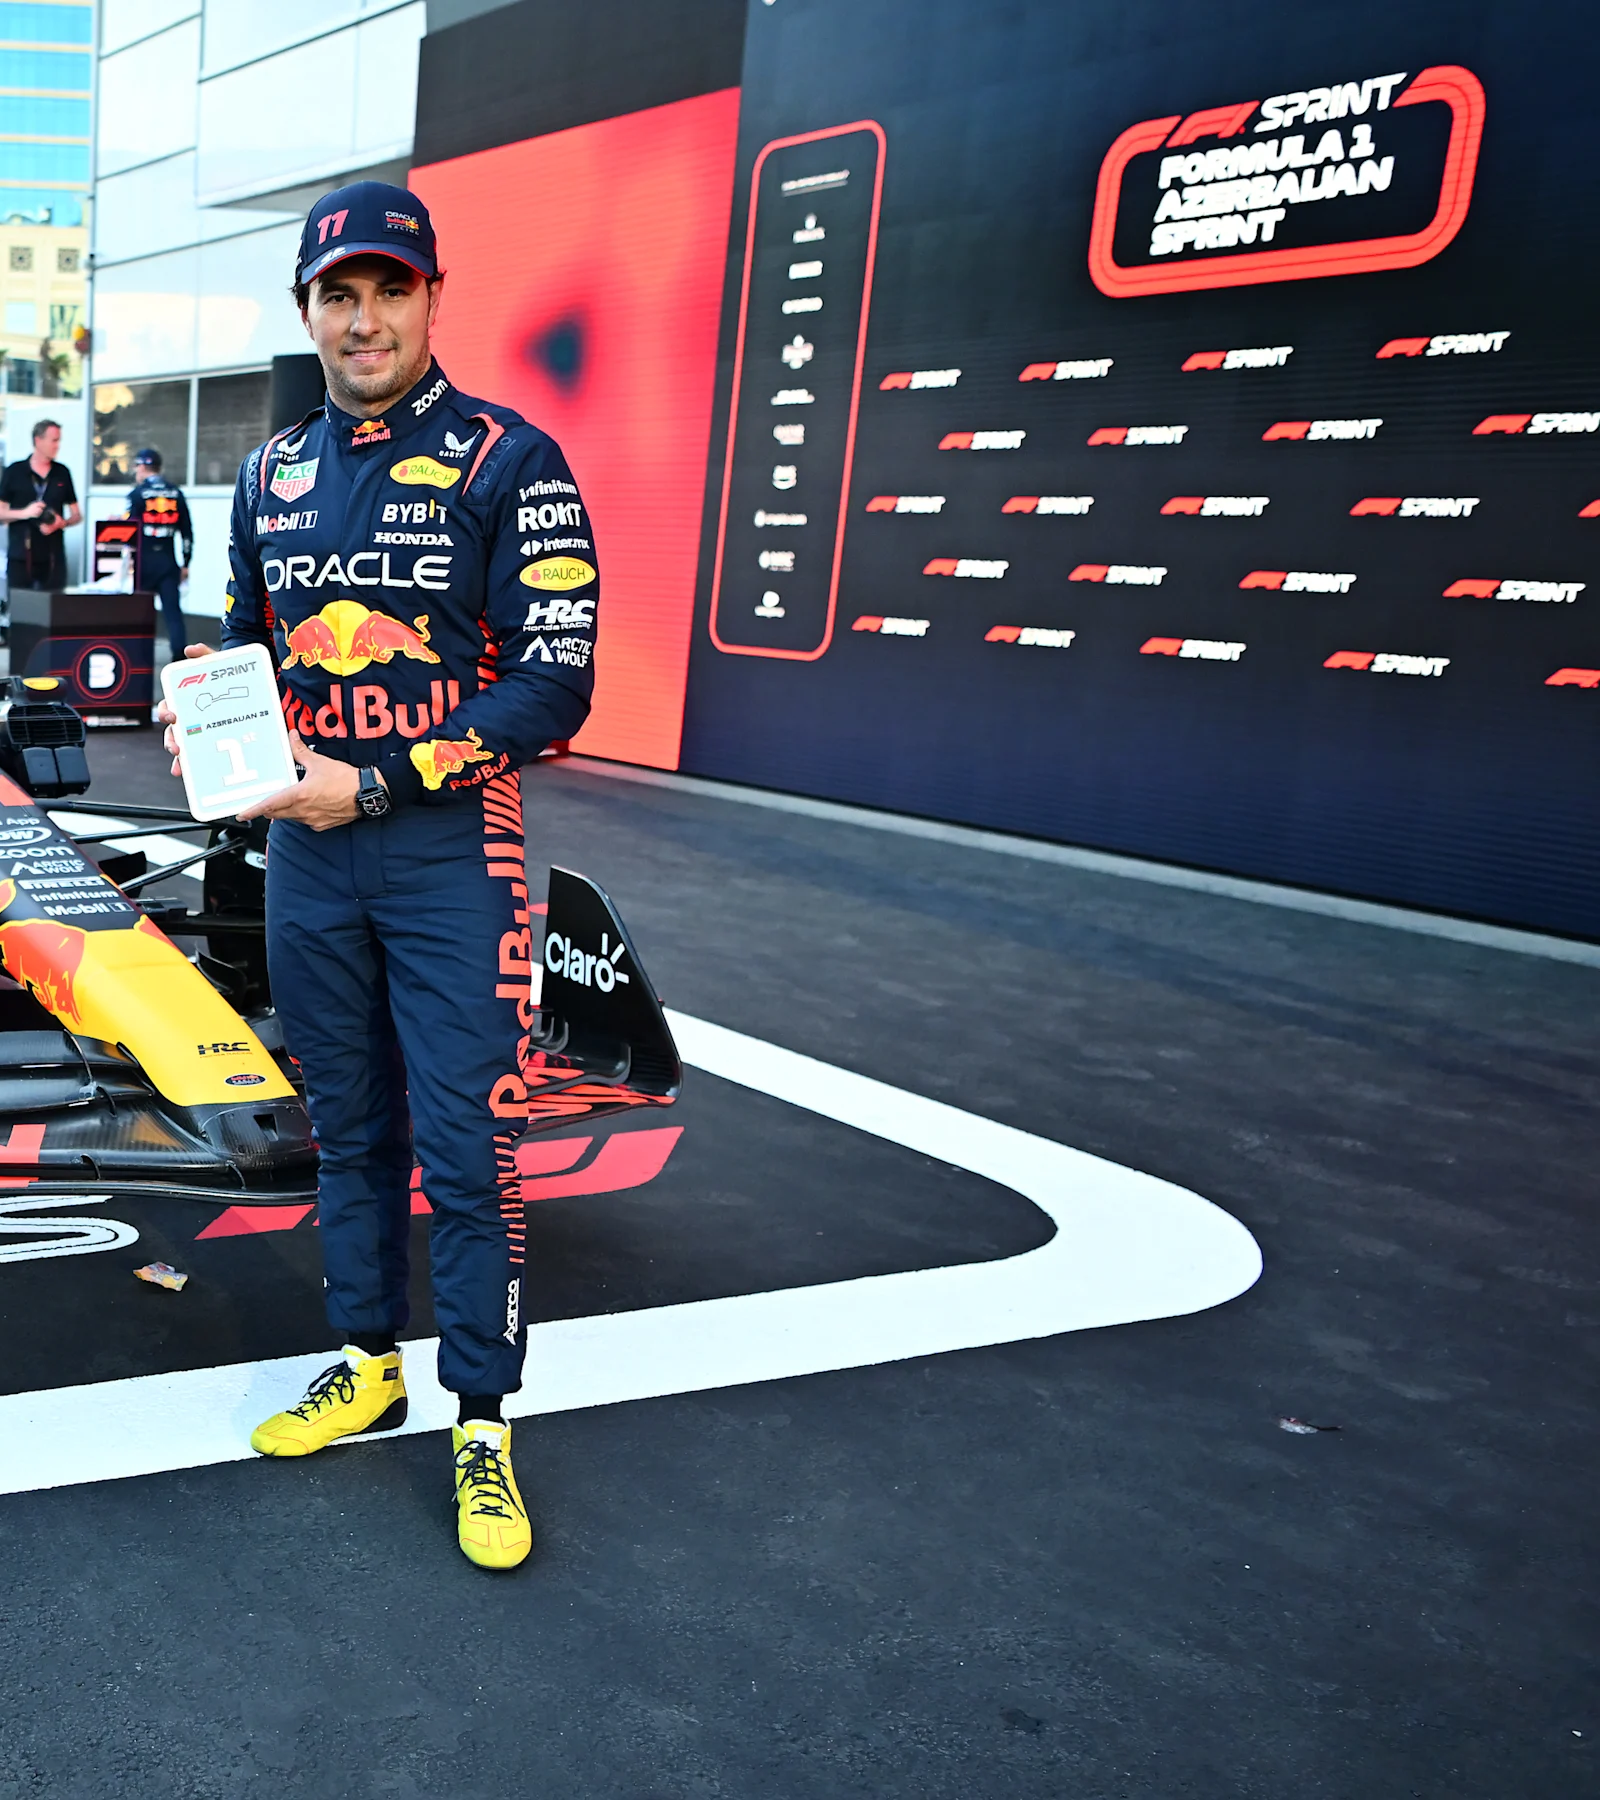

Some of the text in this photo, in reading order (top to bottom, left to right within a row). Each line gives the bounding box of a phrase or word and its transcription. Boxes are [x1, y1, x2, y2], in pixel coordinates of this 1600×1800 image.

[1166, 72, 1407, 148] F1 SPRINT
[1158, 124, 1376, 189] FORMULA 1
[1154, 156, 1395, 223] AZERBAIJAN
[317, 209, 349, 245] 11
[1149, 207, 1286, 256] SPRINT
[1426, 331, 1511, 356] SPRINT
[1223, 346, 1294, 370] SPRINT
[411, 379, 449, 416] zoom
[1307, 418, 1383, 440] SPRINT
[1527, 412, 1600, 434] SPRIN
[351, 428, 391, 447] Red Bull
[280, 464, 315, 480] TAG
[409, 464, 455, 483] RAUCH
[273, 477, 315, 500] HEUER
[518, 479, 578, 503] infinitum
[381, 498, 448, 525] BYBIT
[517, 501, 582, 533] ROKT
[1201, 497, 1270, 517] SPRINT
[1399, 497, 1480, 517] SPRINT
[256, 511, 316, 535] Mobil 1
[373, 532, 455, 547] HONDA
[543, 537, 591, 553] inter.mx
[263, 552, 452, 593] ORACLE
[543, 568, 586, 581] RAUCH
[1282, 572, 1357, 594] SPRINT
[1496, 580, 1586, 603] SPRINT
[524, 599, 596, 626] HRC
[550, 637, 592, 655] ARCTIC
[1179, 640, 1247, 662] SPRINT
[555, 650, 589, 668] WOLF
[1371, 653, 1451, 677] SPRINT
[177, 661, 257, 688] F1 SPRINT
[352, 680, 460, 739] Bull
[448, 752, 511, 791] Red Bull
[6, 817, 41, 827] App
[32, 859, 86, 869] ARCTIC
[41, 865, 85, 875] WOLF
[43, 902, 110, 917] Mobil
[545, 932, 619, 994] Claro
[197, 1042, 251, 1056] HRC
[502, 1277, 521, 1346] sparco
